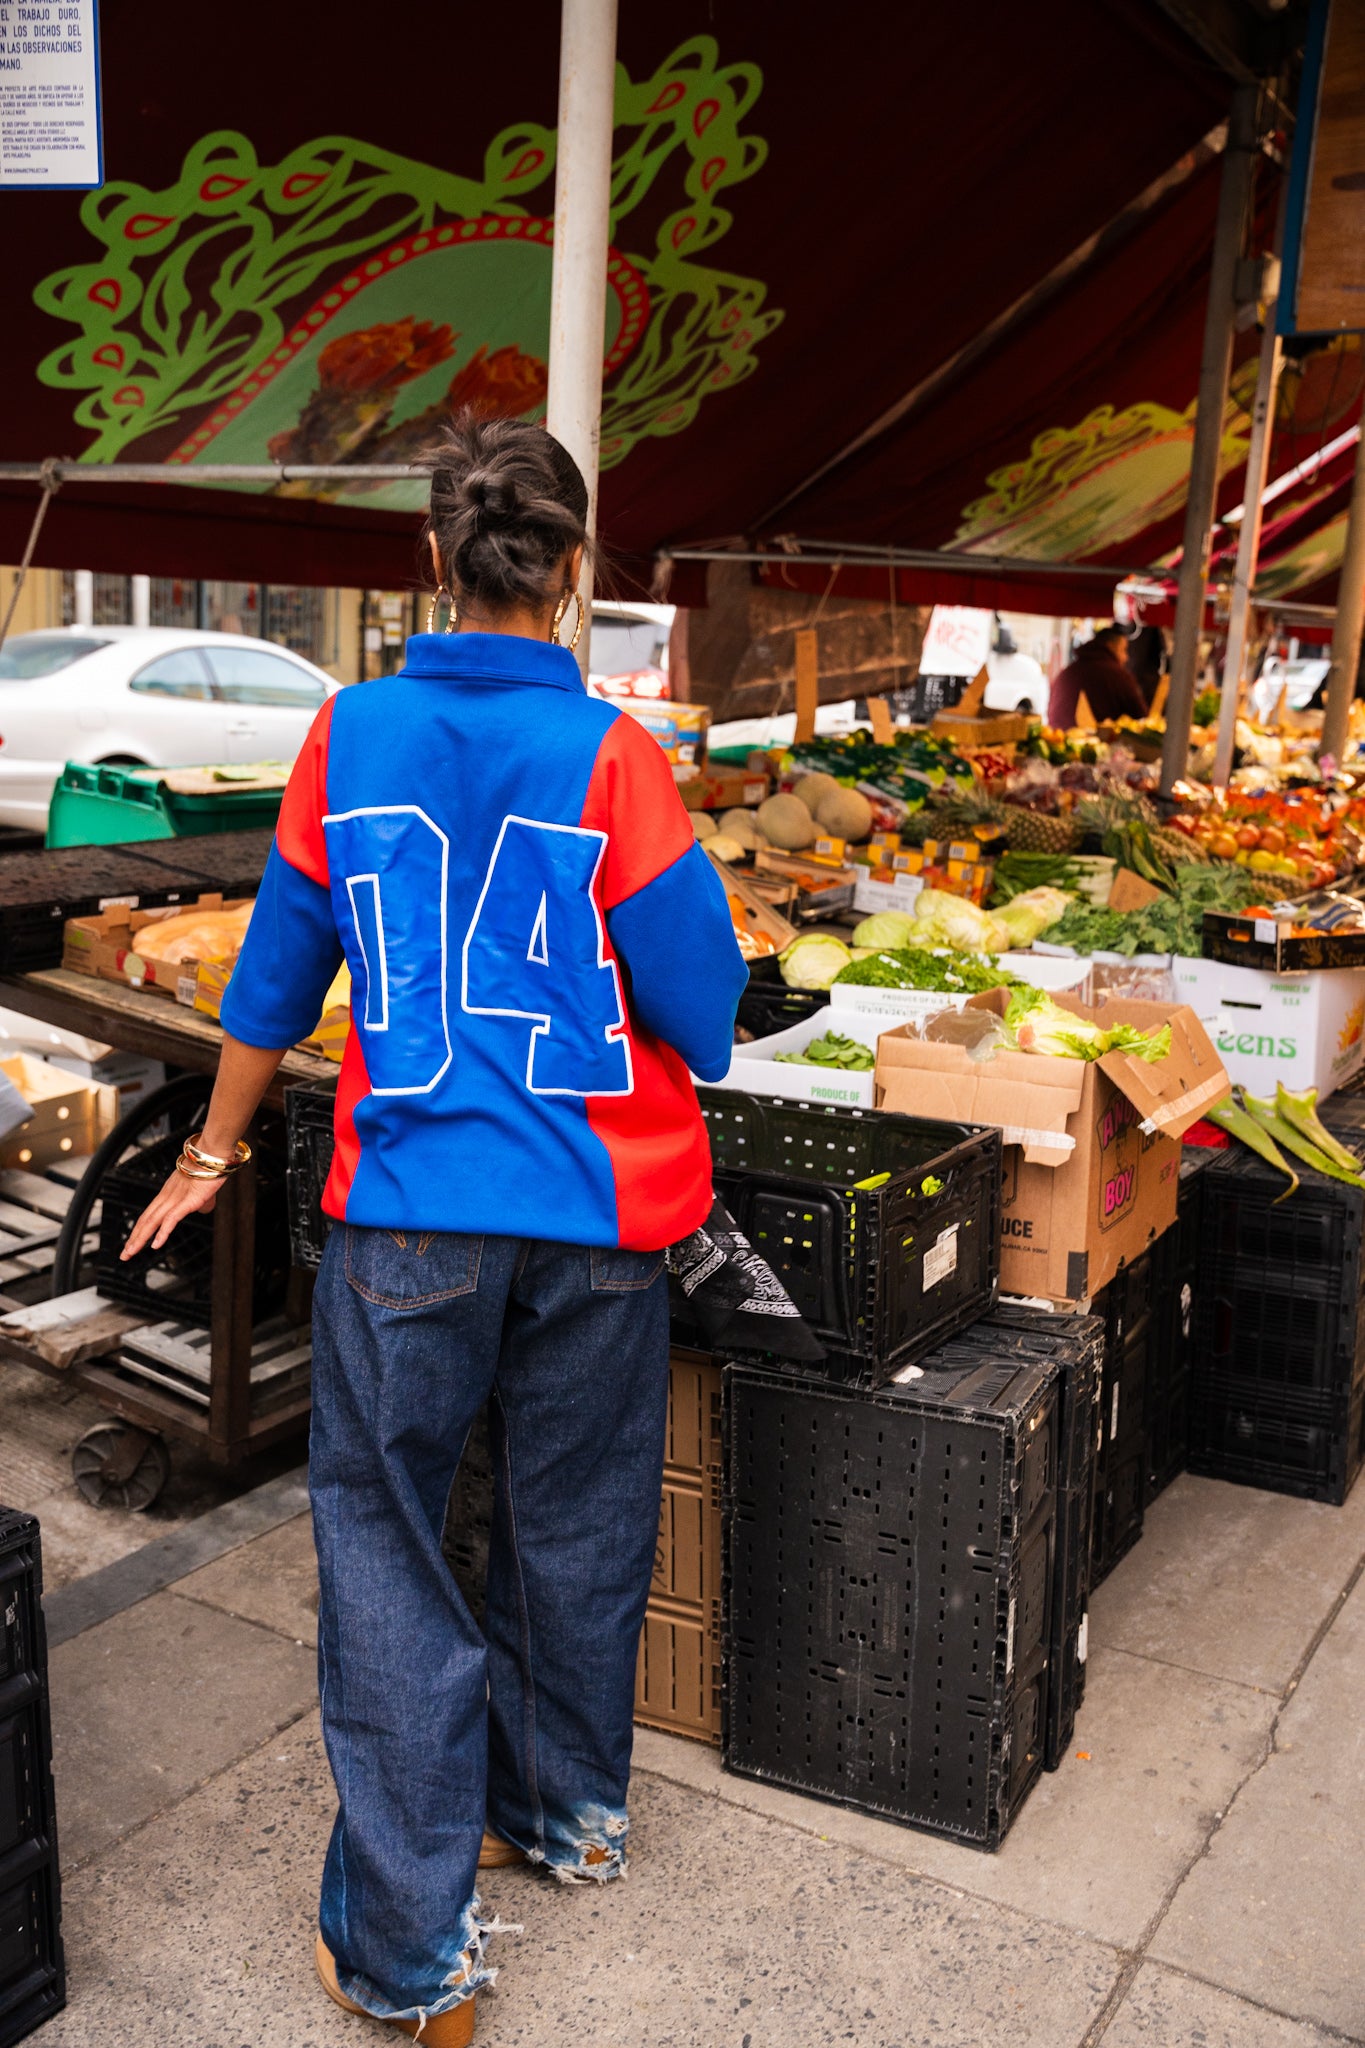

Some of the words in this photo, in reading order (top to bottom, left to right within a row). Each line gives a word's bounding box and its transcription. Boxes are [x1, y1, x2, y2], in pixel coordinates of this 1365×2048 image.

[1, 9, 10, 21] EL
[18, 8, 50, 20] TRABAJO
[59, 8, 81, 20] DURO,
[14, 25, 28, 37] LOS
[34, 25, 61, 37] DICHOS
[67, 24, 82, 36] DEL
[7, 42, 20, 54] LAS
[22, 41, 82, 53] OBSERVACIONES
[810, 1086, 849, 1100] PRODUCE
[1105, 1165, 1134, 1217] BOY
[1000, 1216, 1034, 1239] UCE
